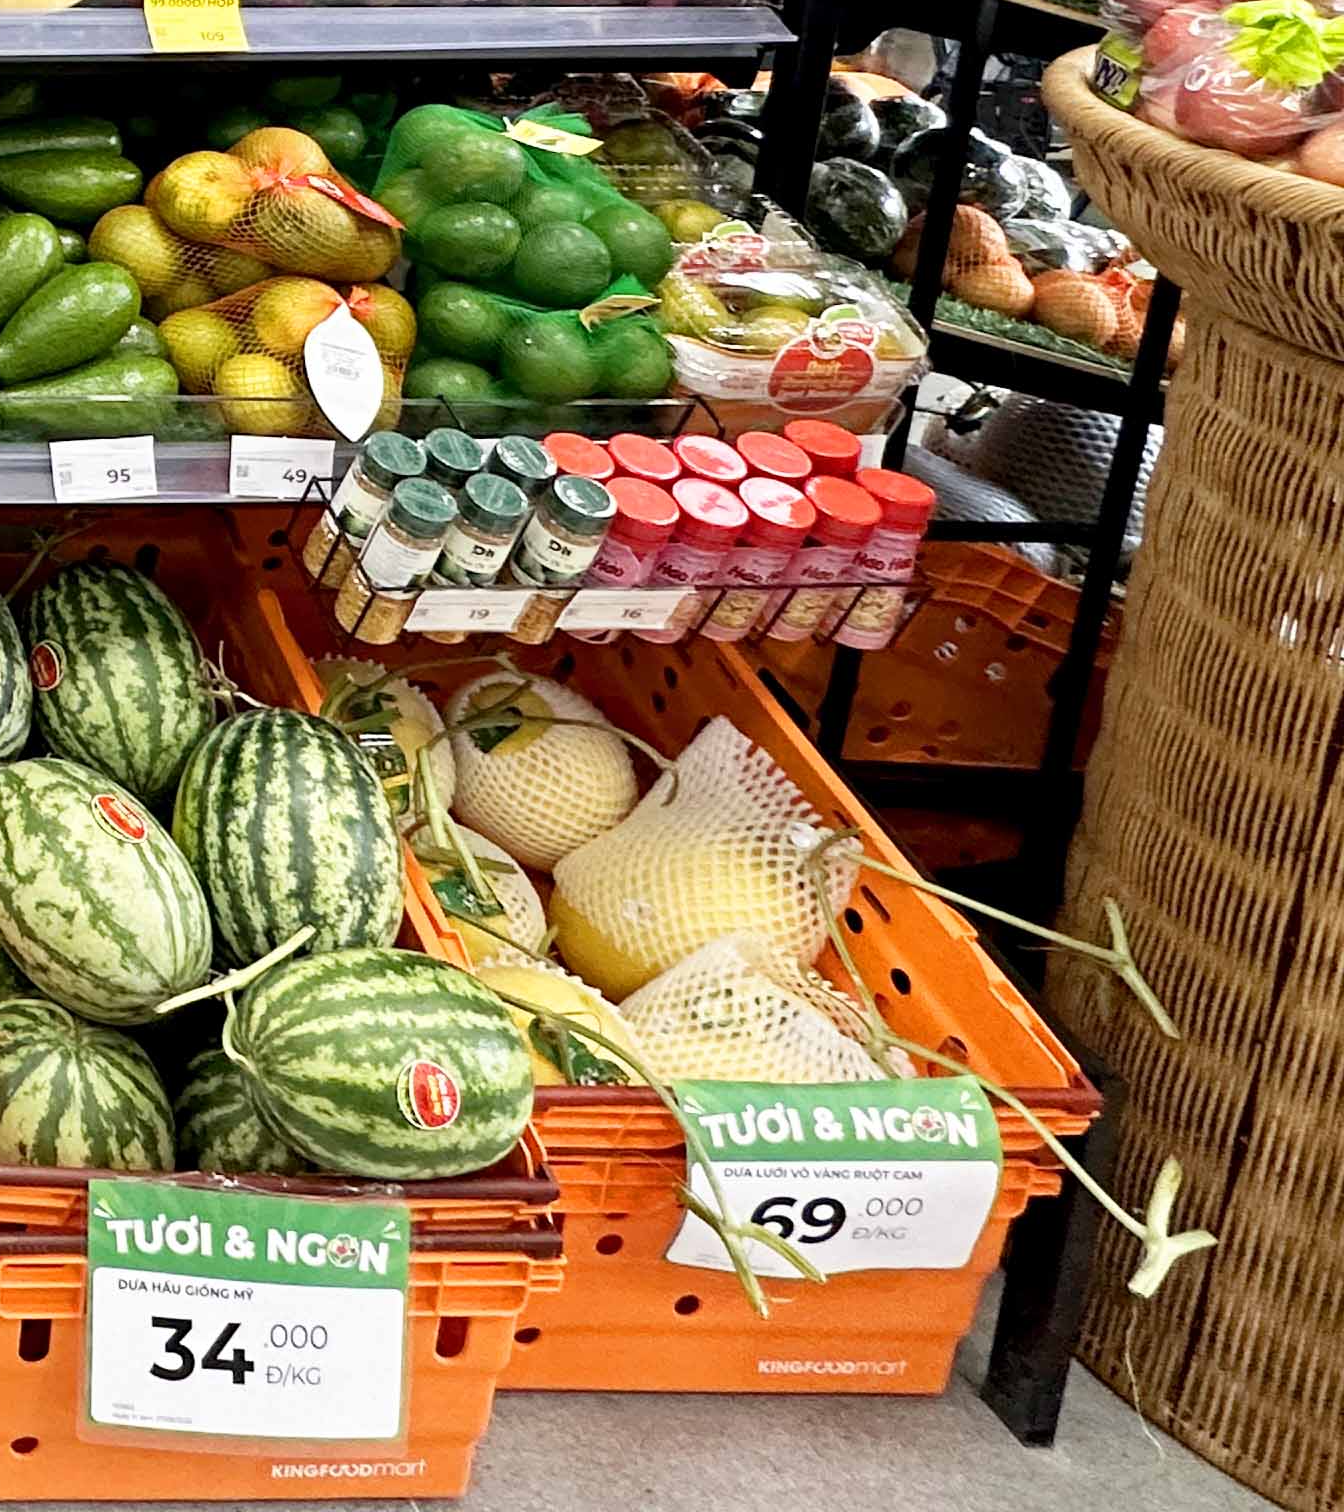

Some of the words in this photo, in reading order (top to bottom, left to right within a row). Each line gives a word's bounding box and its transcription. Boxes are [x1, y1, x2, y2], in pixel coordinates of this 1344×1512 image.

[107, 468, 131, 484] 95
[283, 468, 307, 483] 49
[469, 609, 489, 619] 19
[621, 608, 642, 619] 16
[699, 1103, 804, 1148] TƯƠI
[813, 1106, 845, 1142] &
[894, 1169, 923, 1181] CAM
[107, 1213, 212, 1258] TƯƠI
[224, 1224, 255, 1259] &
[852, 1226, 908, 1241] Đ/KG
[149, 1315, 255, 1385] 34
[264, 1323, 329, 1351] .000
[265, 1363, 322, 1387] Đ/KG
[758, 1359, 906, 1377] KINGFOODmart
[271, 1457, 427, 1480] KINGFOODmart
